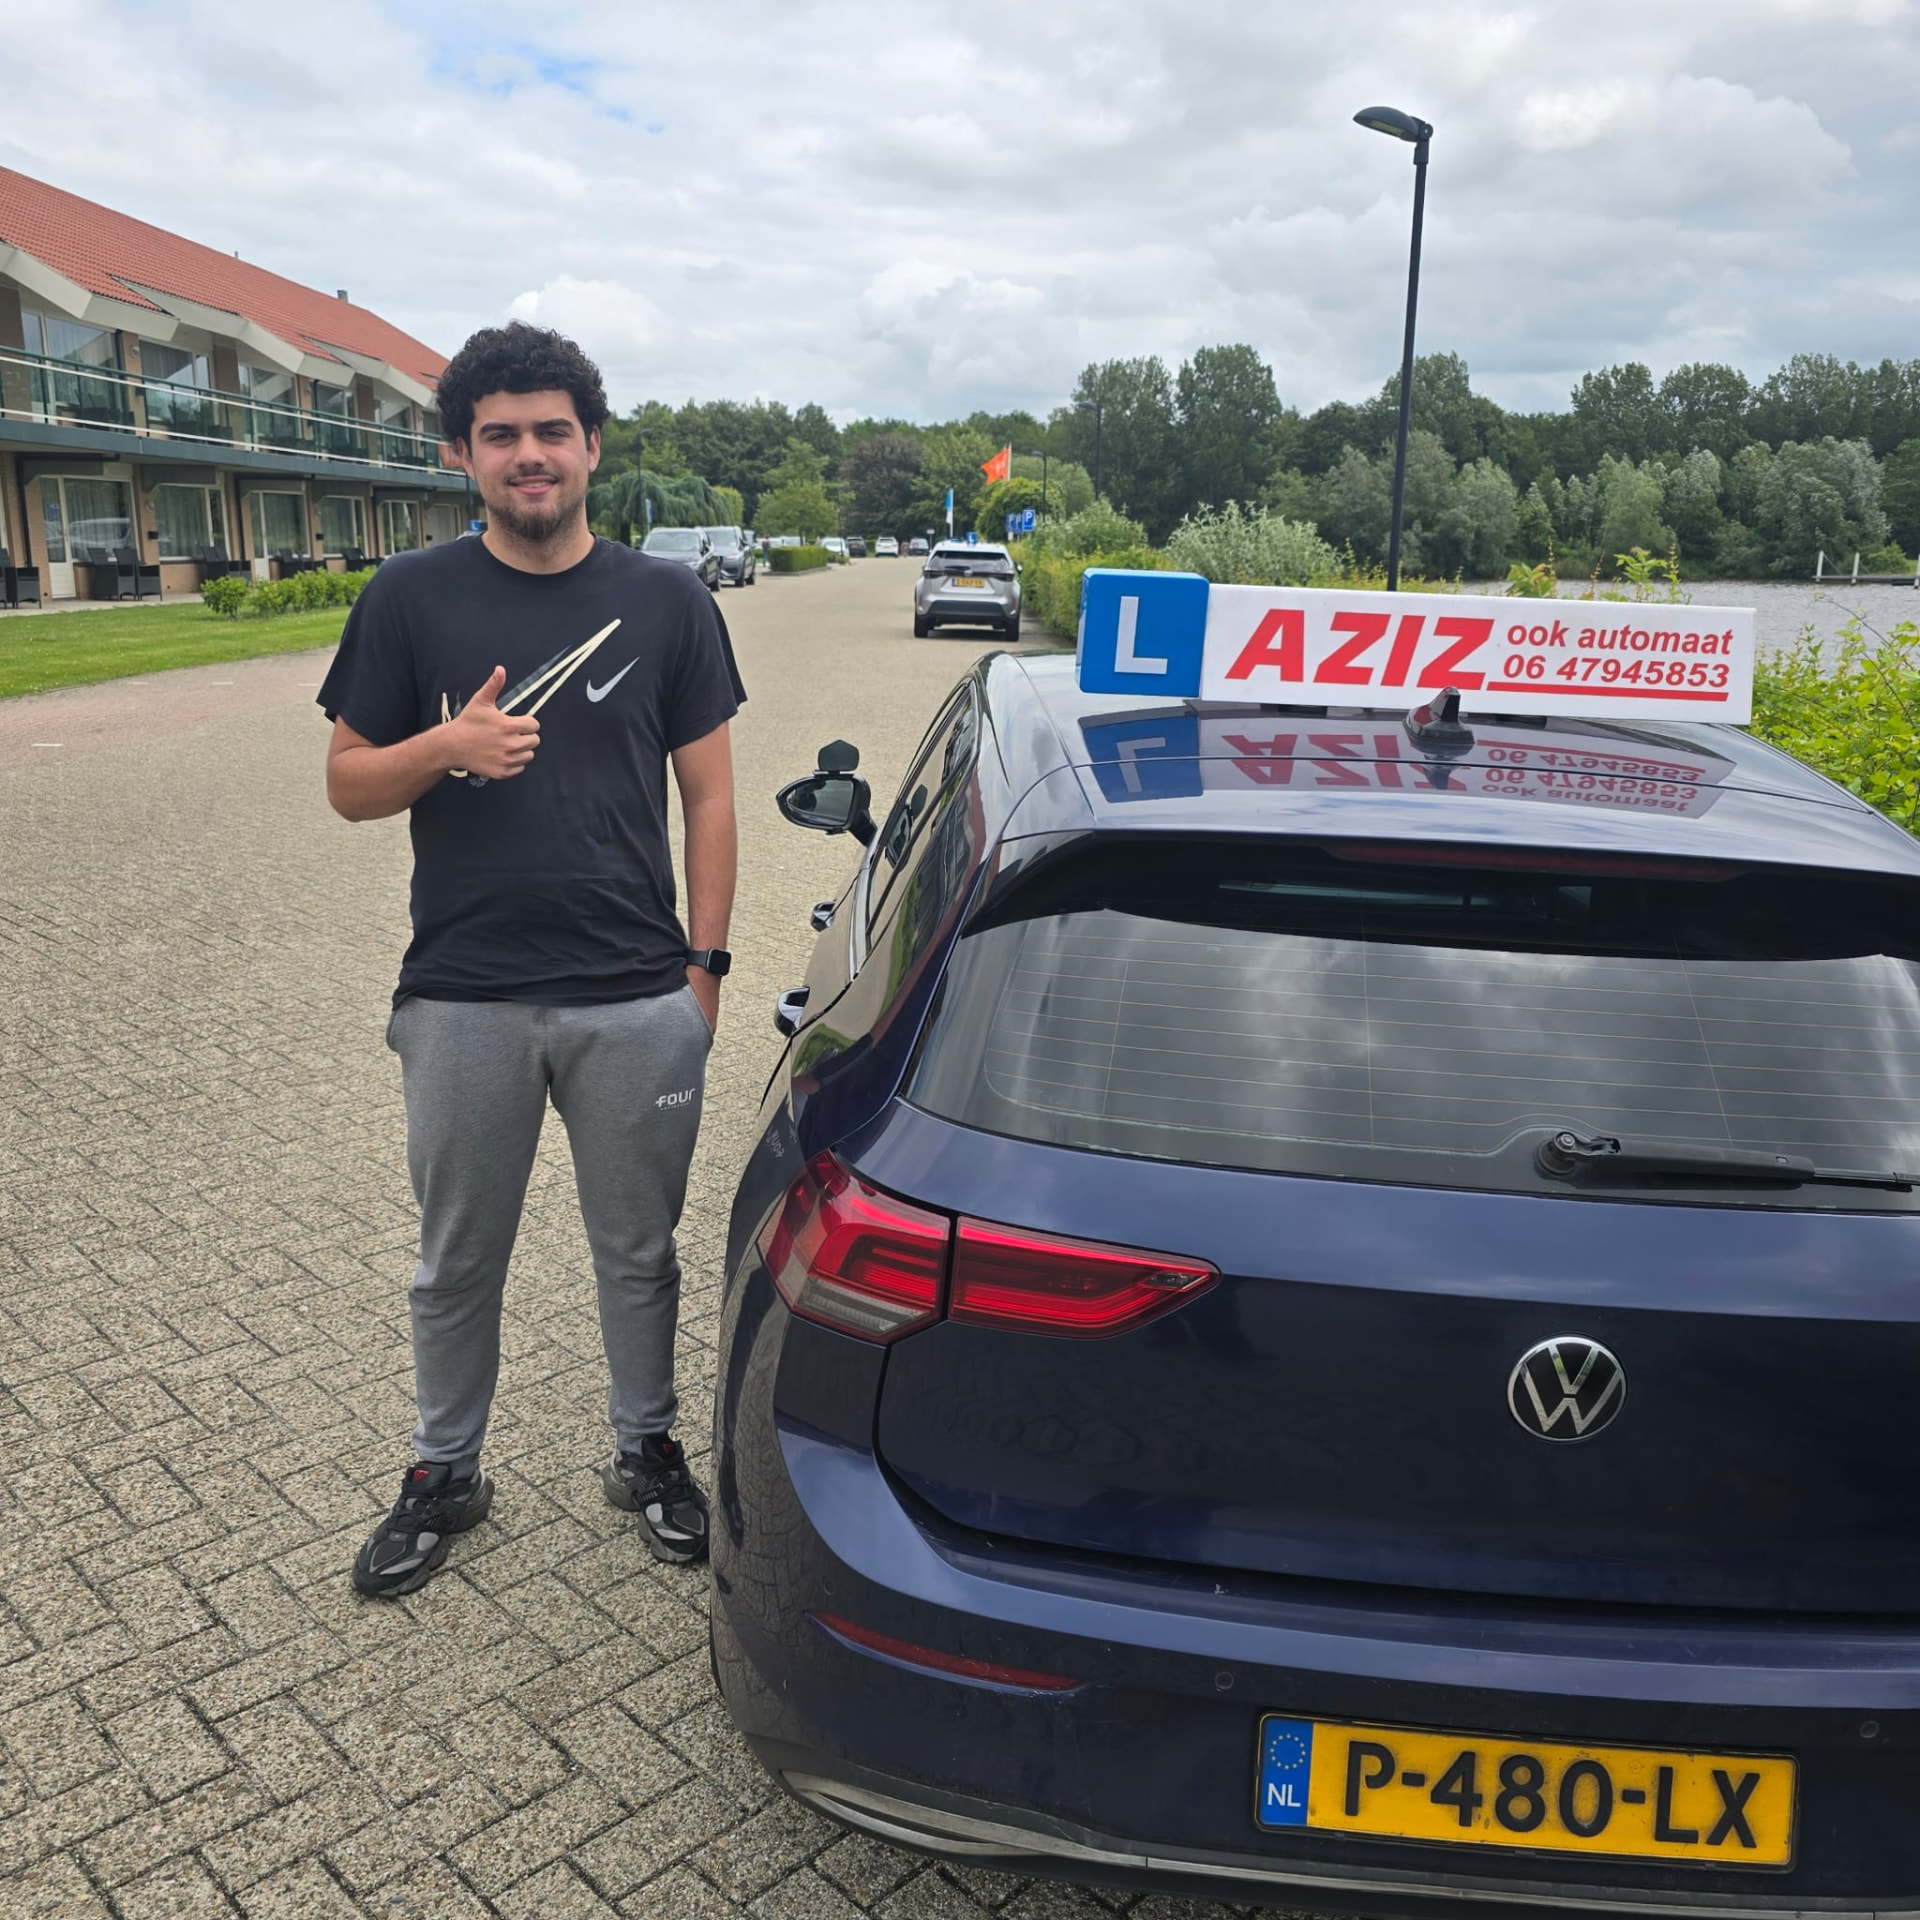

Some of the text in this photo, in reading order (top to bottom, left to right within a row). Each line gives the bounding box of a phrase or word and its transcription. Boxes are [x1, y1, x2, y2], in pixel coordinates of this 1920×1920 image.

[1025, 511, 1033, 522] P
[1114, 596, 1168, 674] L
[1224, 608, 1495, 691] AZIZ
[1507, 620, 1734, 655] ook automaat
[1503, 654, 1730, 688] 06 47945853
[1267, 1782, 1301, 1808] NL
[1344, 1740, 1760, 1848] P-480-LX
